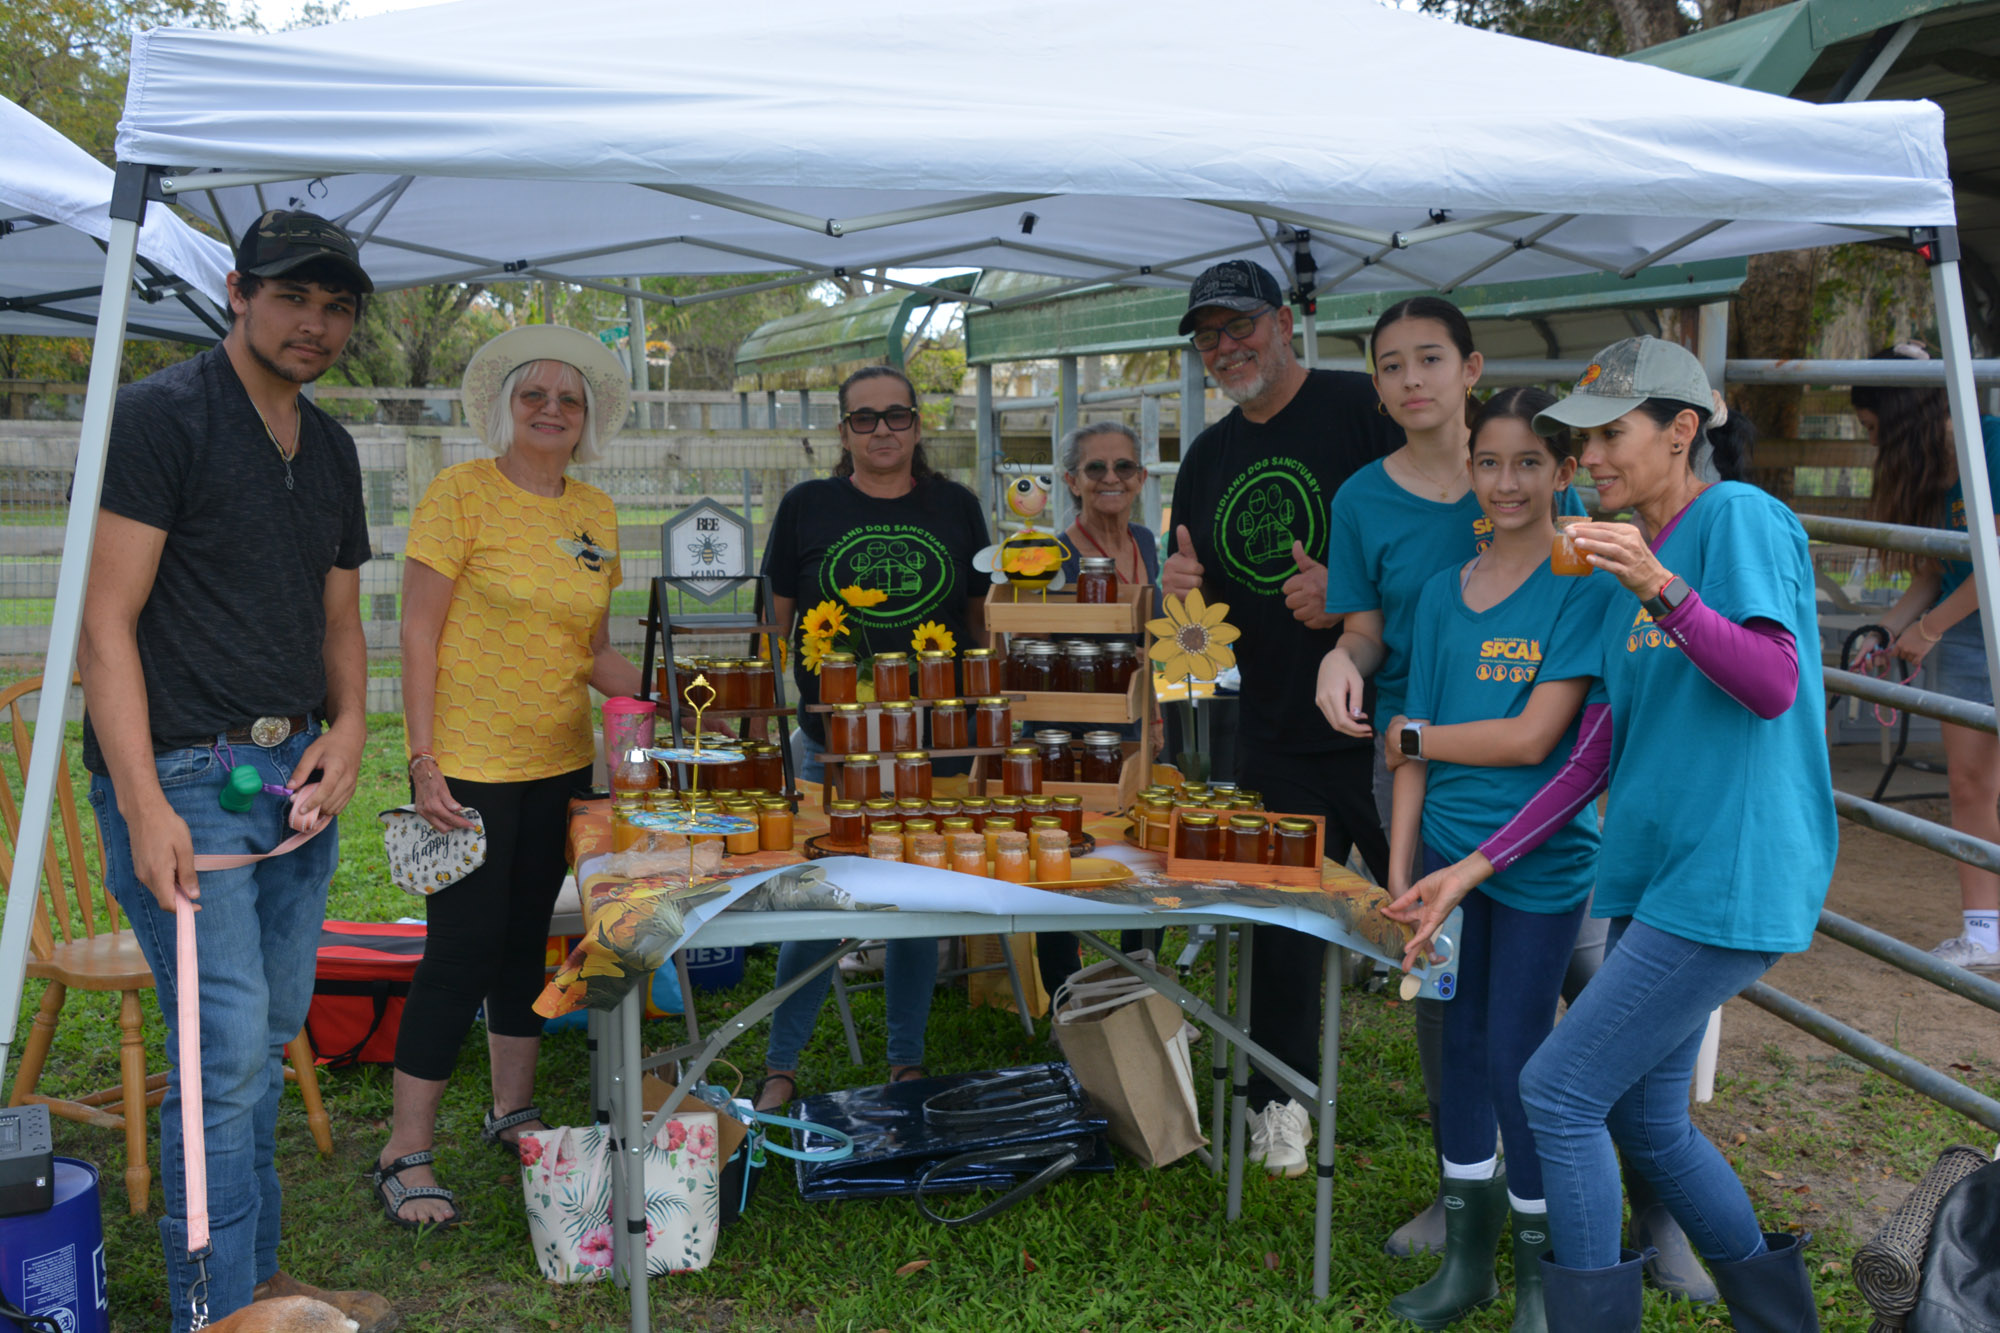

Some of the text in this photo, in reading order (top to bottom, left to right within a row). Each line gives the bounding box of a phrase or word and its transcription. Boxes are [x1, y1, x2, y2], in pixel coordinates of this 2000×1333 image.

[1247, 458, 1269, 475] DOG
[1271, 456, 1321, 493] SANCTUARY
[696, 518, 720, 531] BEE
[825, 527, 863, 556] EDLAND
[691, 569, 726, 582] KIND
[1480, 640, 1530, 660] SPCA
[412, 833, 449, 865] happy
[1969, 919, 1990, 929] alo
